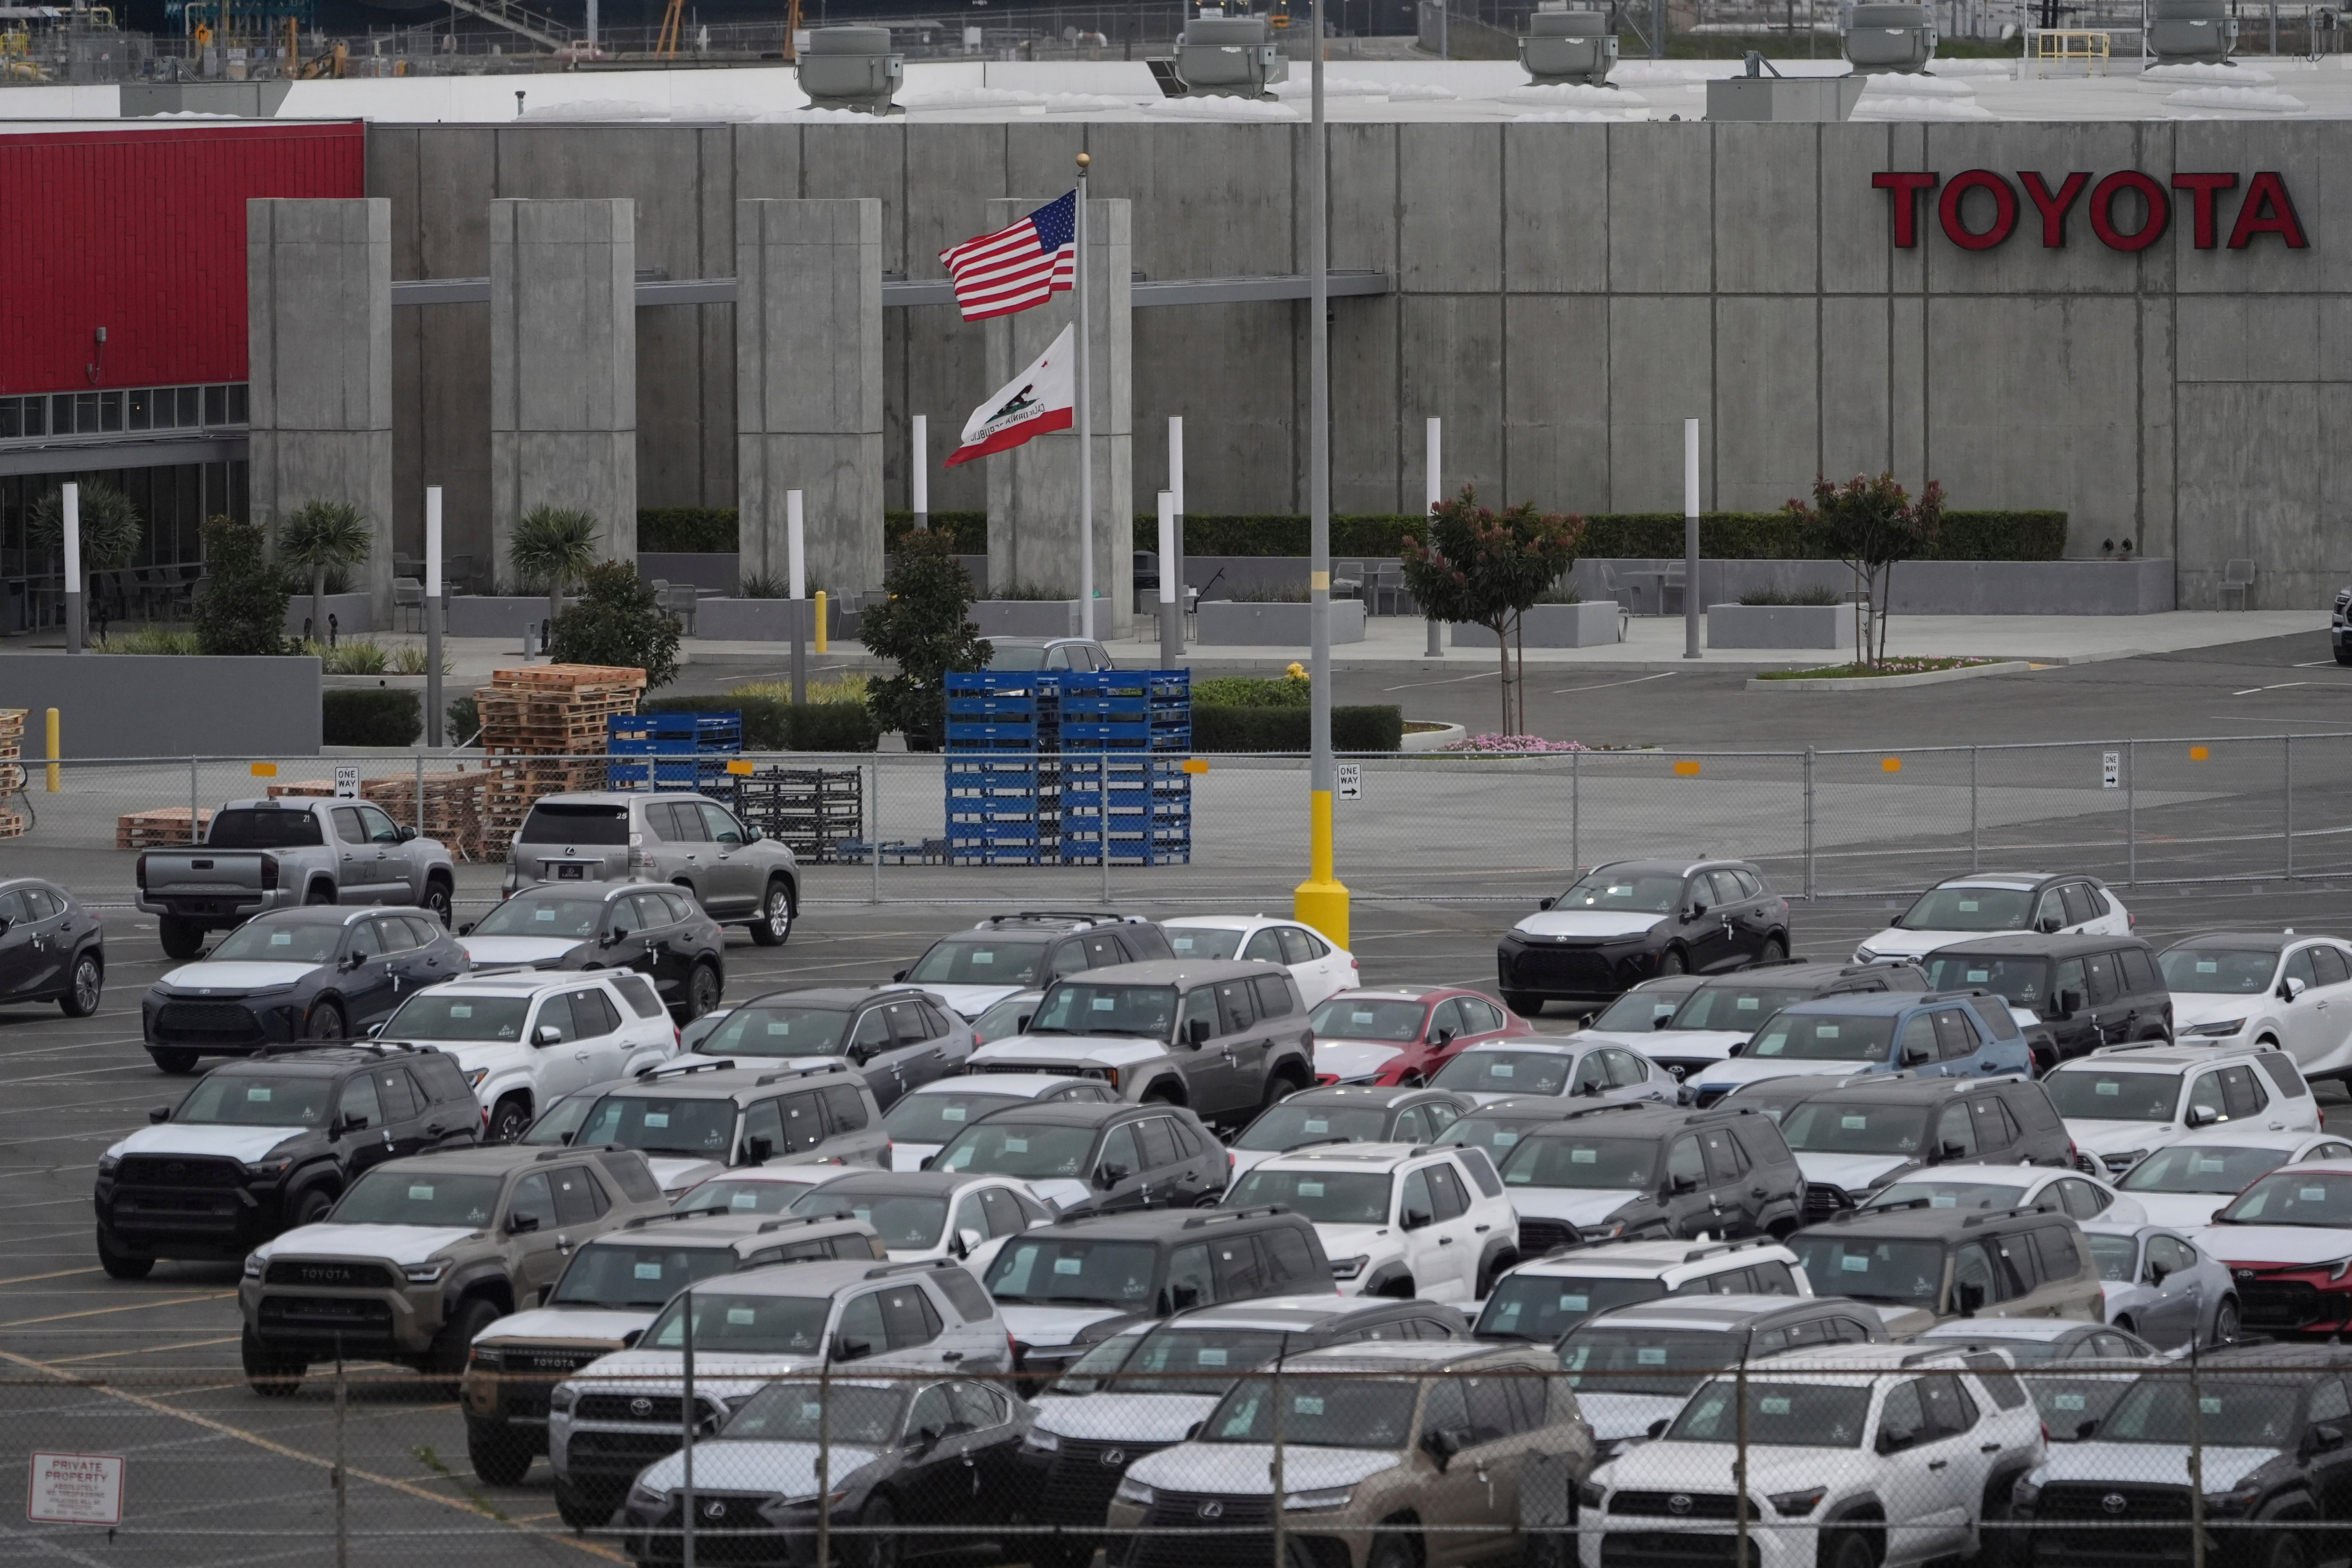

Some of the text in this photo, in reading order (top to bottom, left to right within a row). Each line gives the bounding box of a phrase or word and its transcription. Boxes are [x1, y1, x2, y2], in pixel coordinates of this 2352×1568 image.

[1872, 169, 2310, 251] TOYOTA
[301, 1269, 350, 1279] TOYOTA
[533, 1358, 575, 1368] TOYOTA
[53, 1461, 102, 1472] PRIVATE
[45, 1471, 108, 1483] PROPERTY
